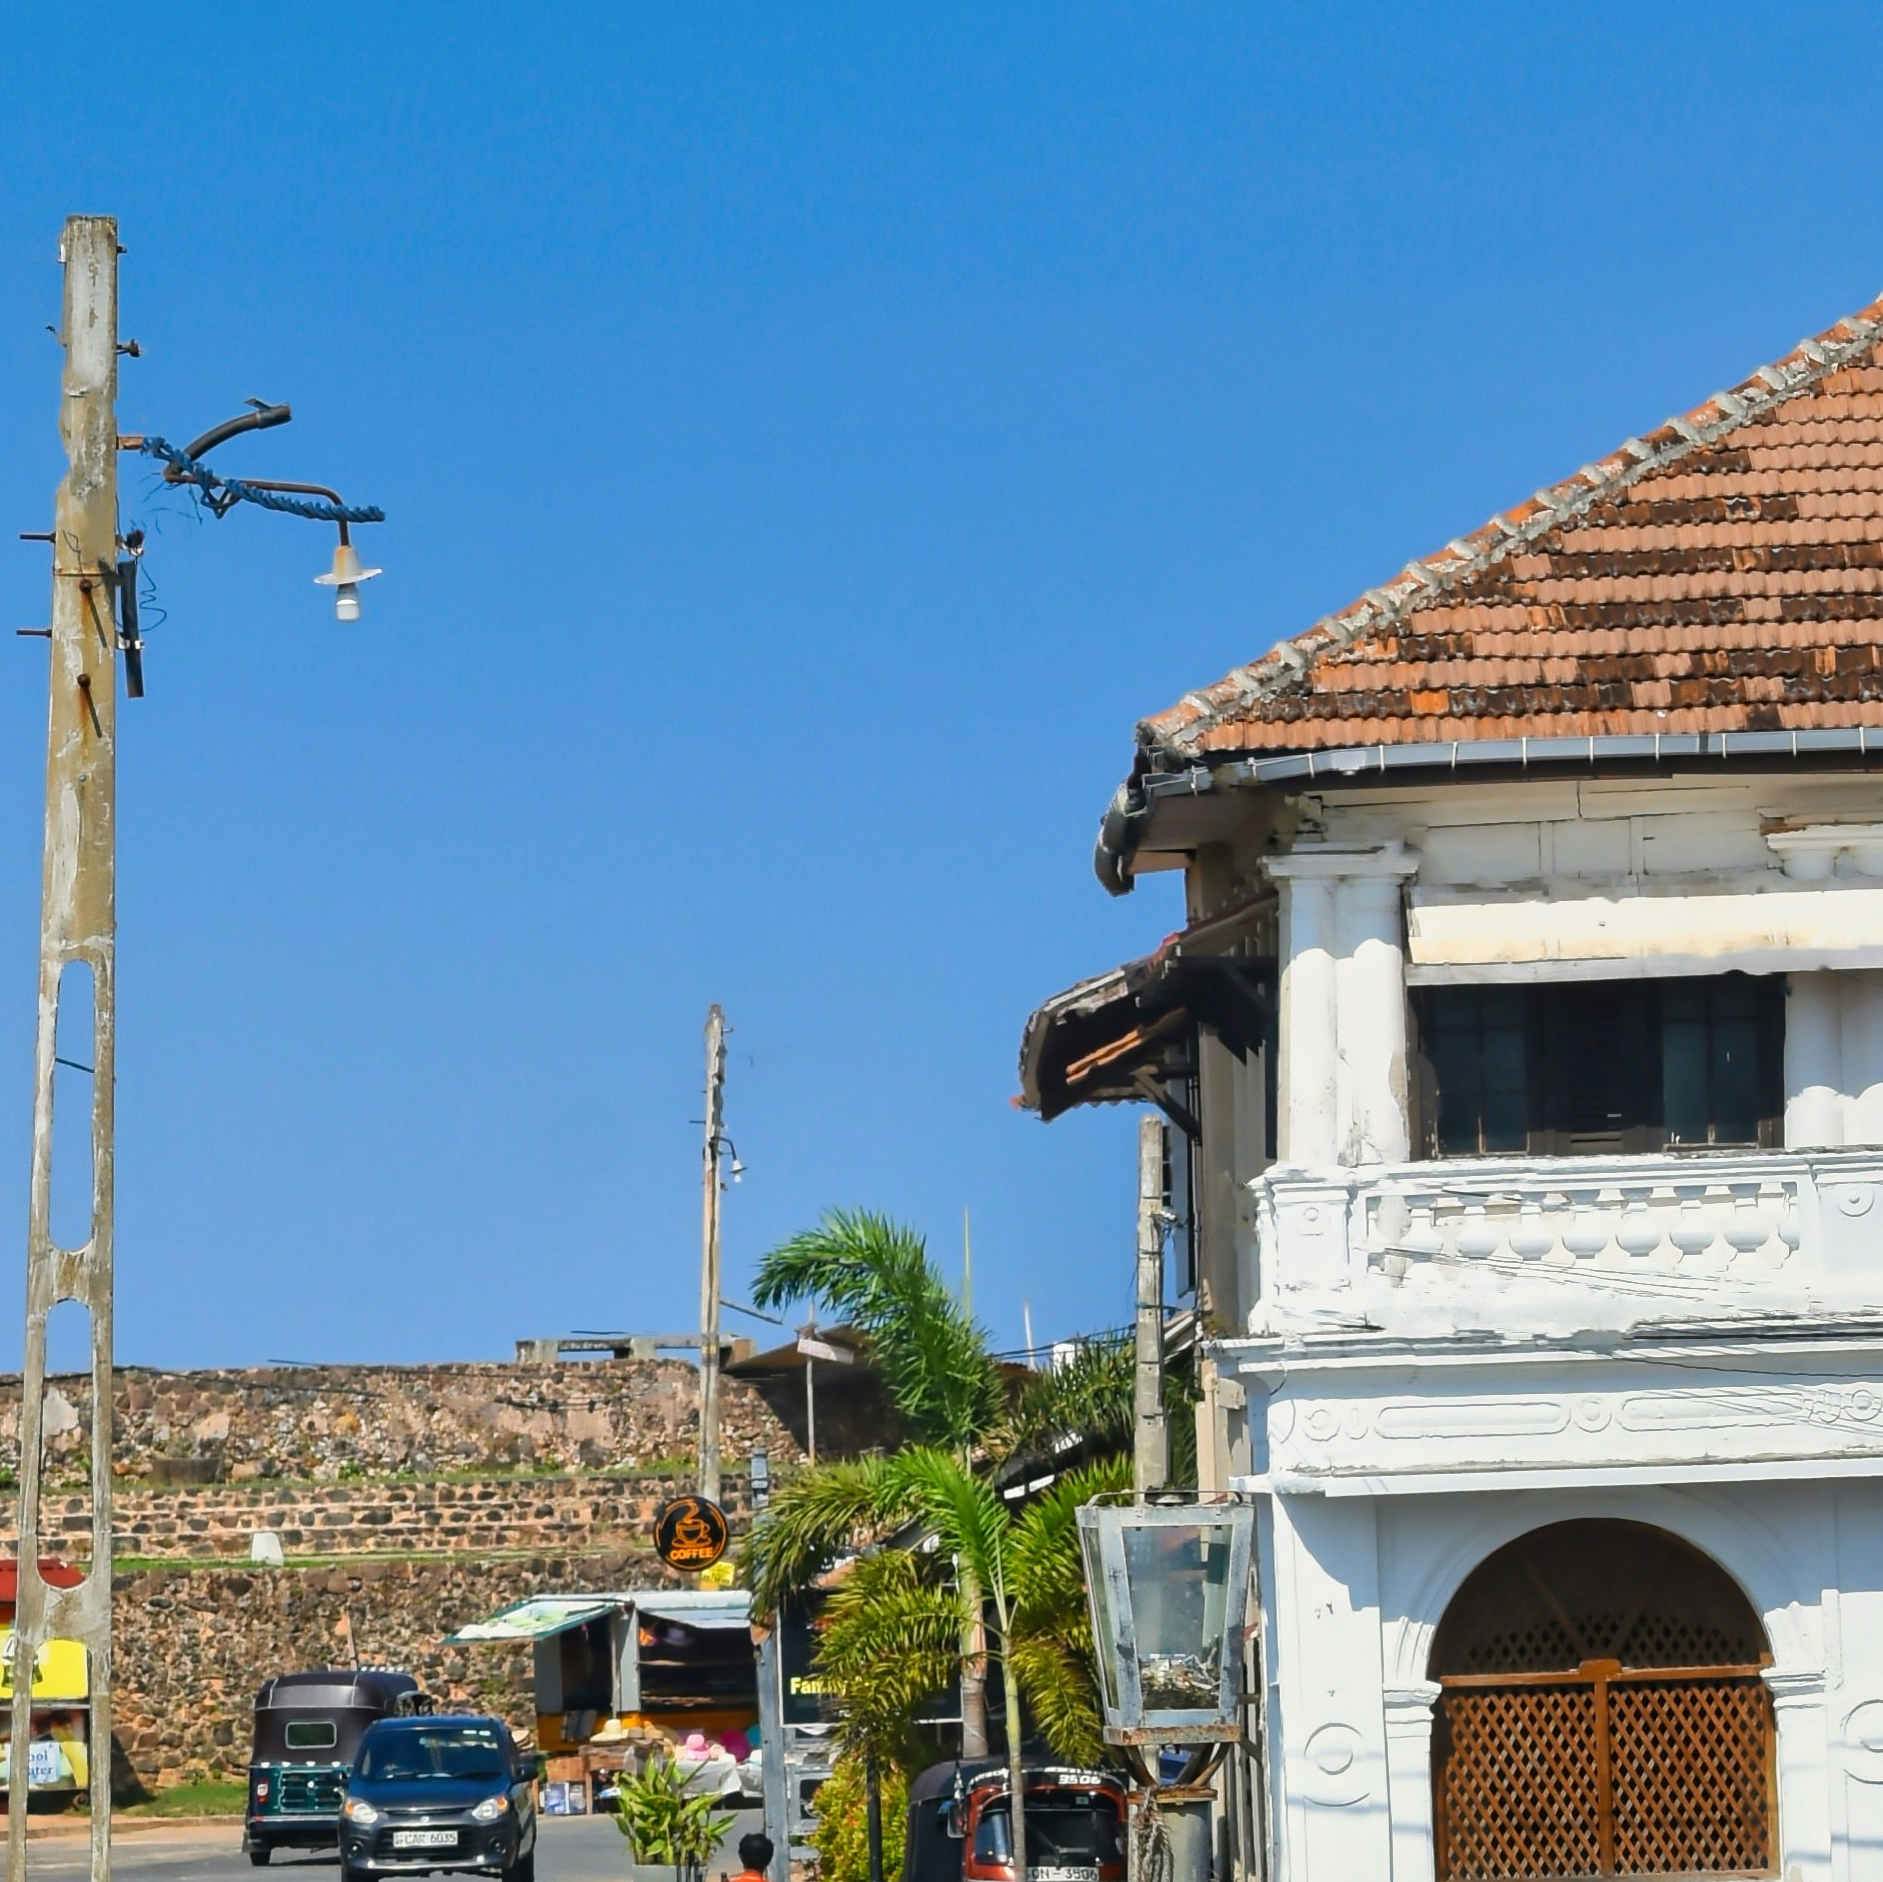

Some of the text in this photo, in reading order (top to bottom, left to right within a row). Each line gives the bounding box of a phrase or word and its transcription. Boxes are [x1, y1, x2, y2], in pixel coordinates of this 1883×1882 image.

[670, 1547, 713, 1560] COFFEE
[29, 1749, 48, 1762] ool
[29, 1766, 53, 1775] ater
[1064, 1868, 1098, 1881] 3506
